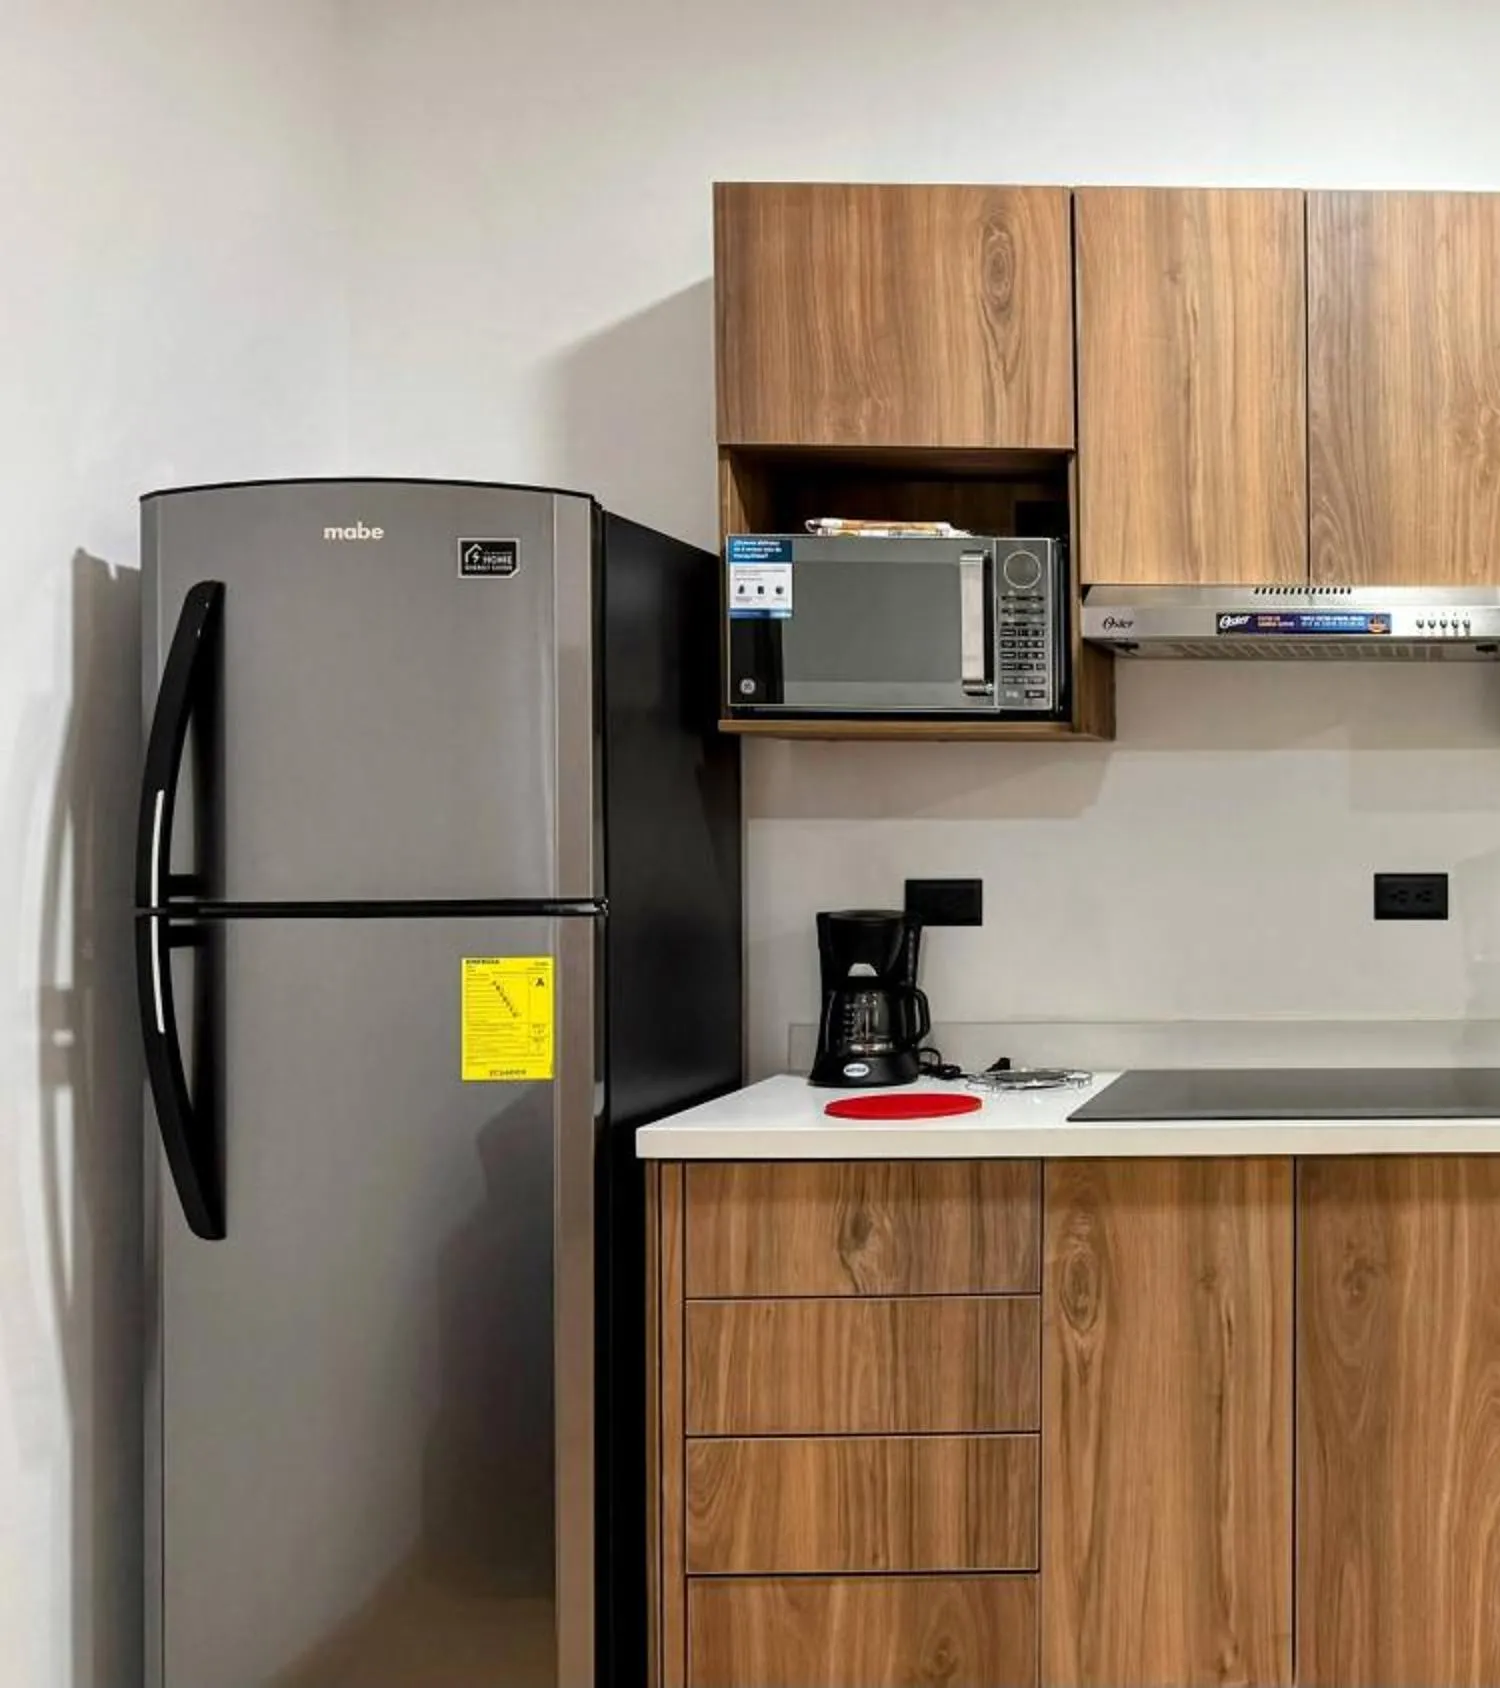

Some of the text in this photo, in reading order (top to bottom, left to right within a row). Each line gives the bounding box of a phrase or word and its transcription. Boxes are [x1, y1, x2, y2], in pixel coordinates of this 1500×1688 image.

[323, 521, 384, 540] mabe
[1102, 616, 1134, 630] Oster
[1219, 614, 1252, 629] Oster
